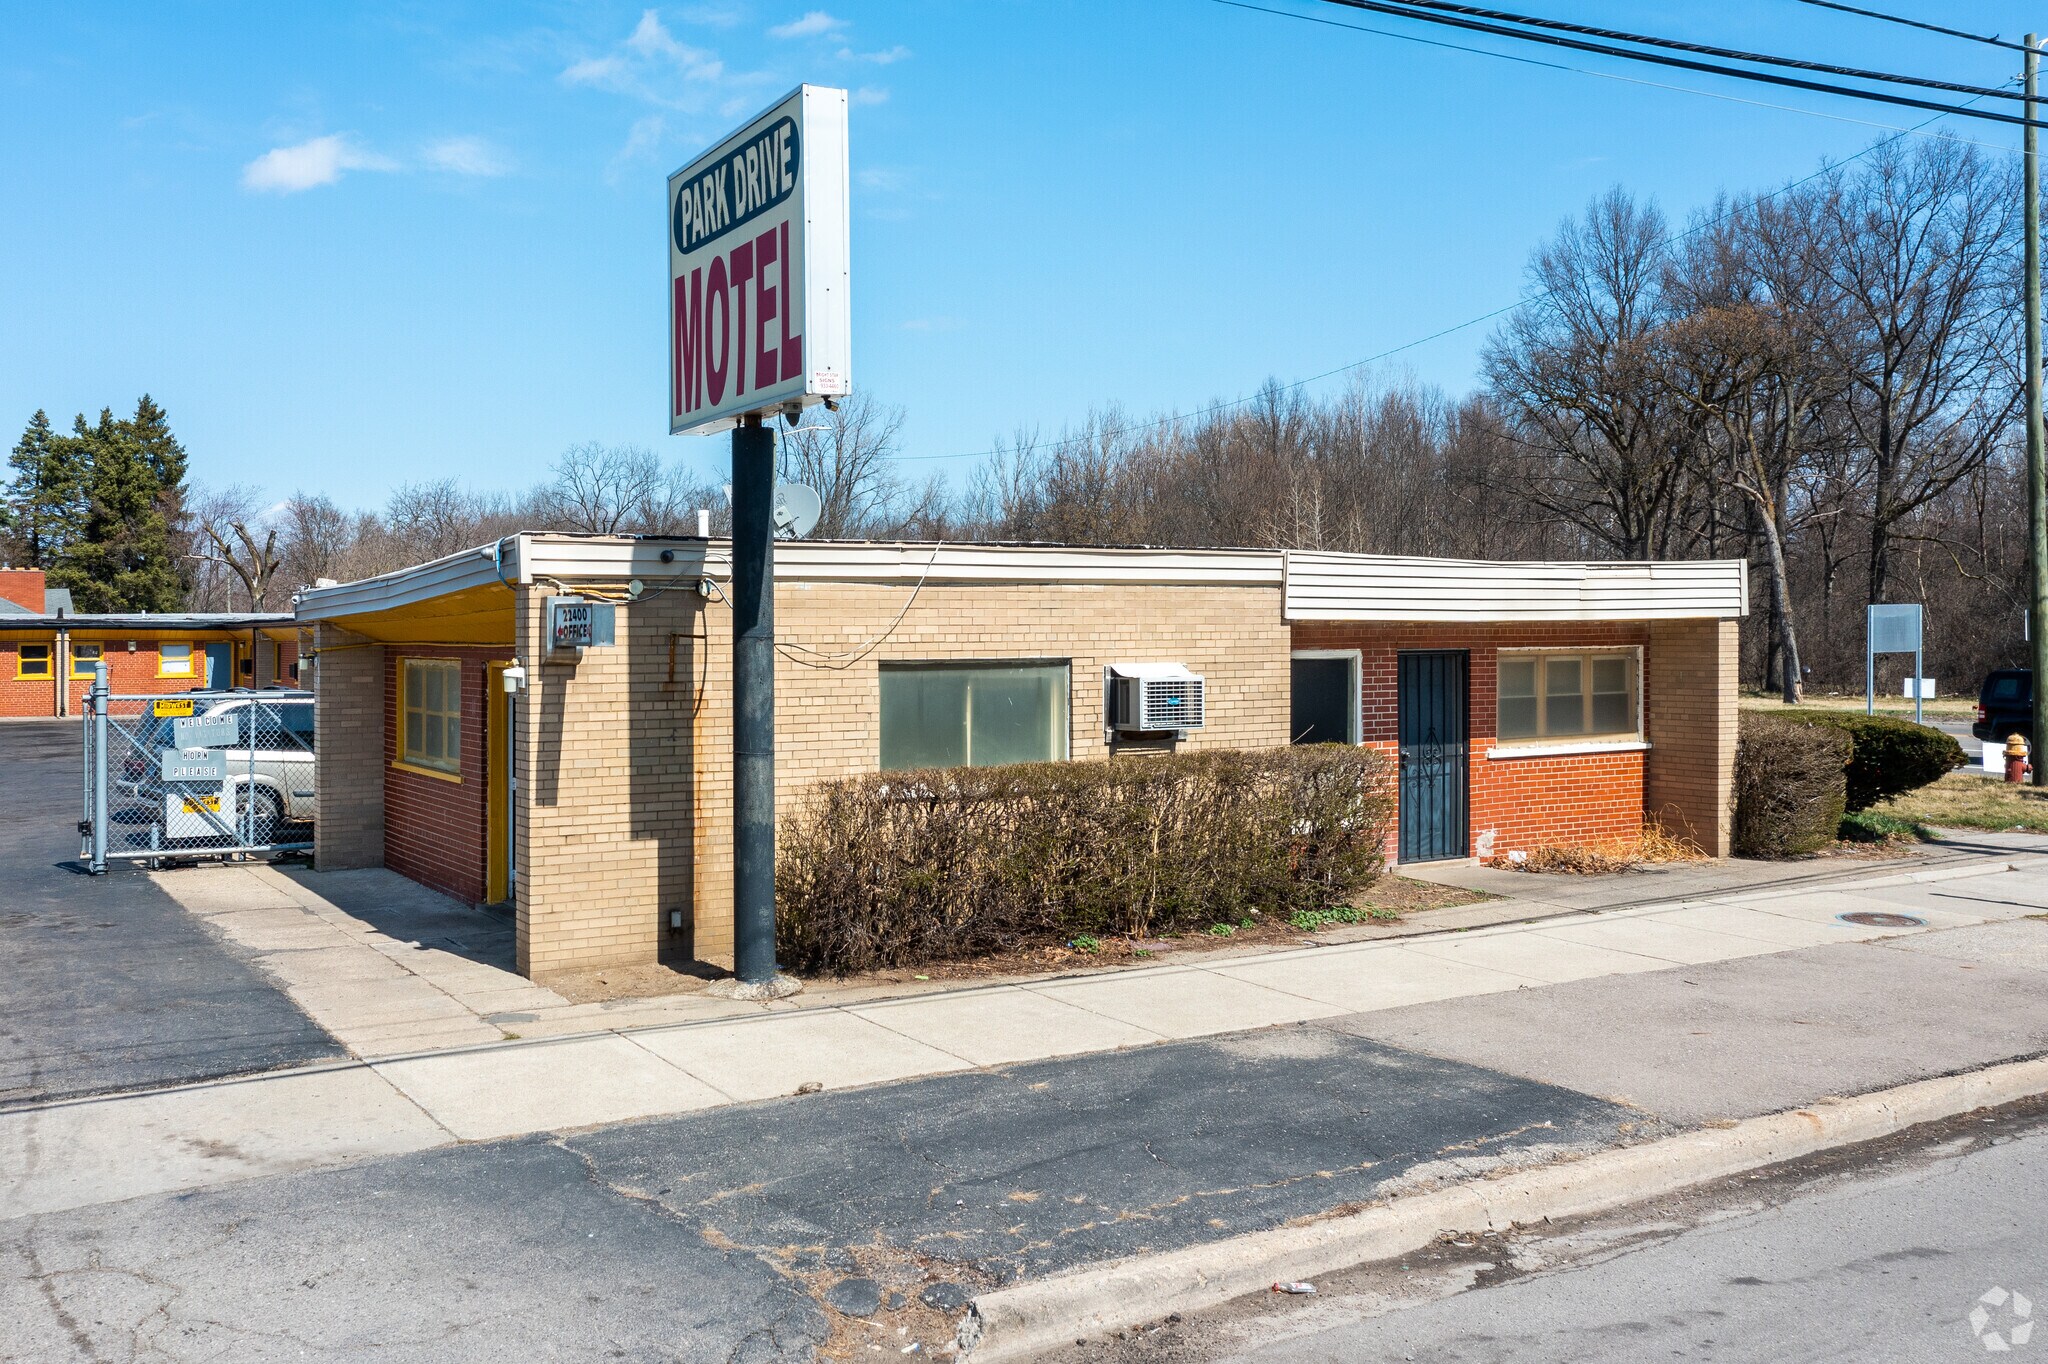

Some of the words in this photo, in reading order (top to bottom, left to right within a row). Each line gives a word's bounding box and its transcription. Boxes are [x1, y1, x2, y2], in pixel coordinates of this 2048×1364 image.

[681, 163, 730, 248] PARK
[733, 121, 793, 219] DRIVE
[674, 219, 802, 417] MOTEL
[563, 608, 587, 622] 22400
[563, 624, 587, 638] OFFICE
[181, 715, 232, 727] WELCOME
[183, 751, 208, 760] HORN
[173, 767, 216, 776] PLEASE
